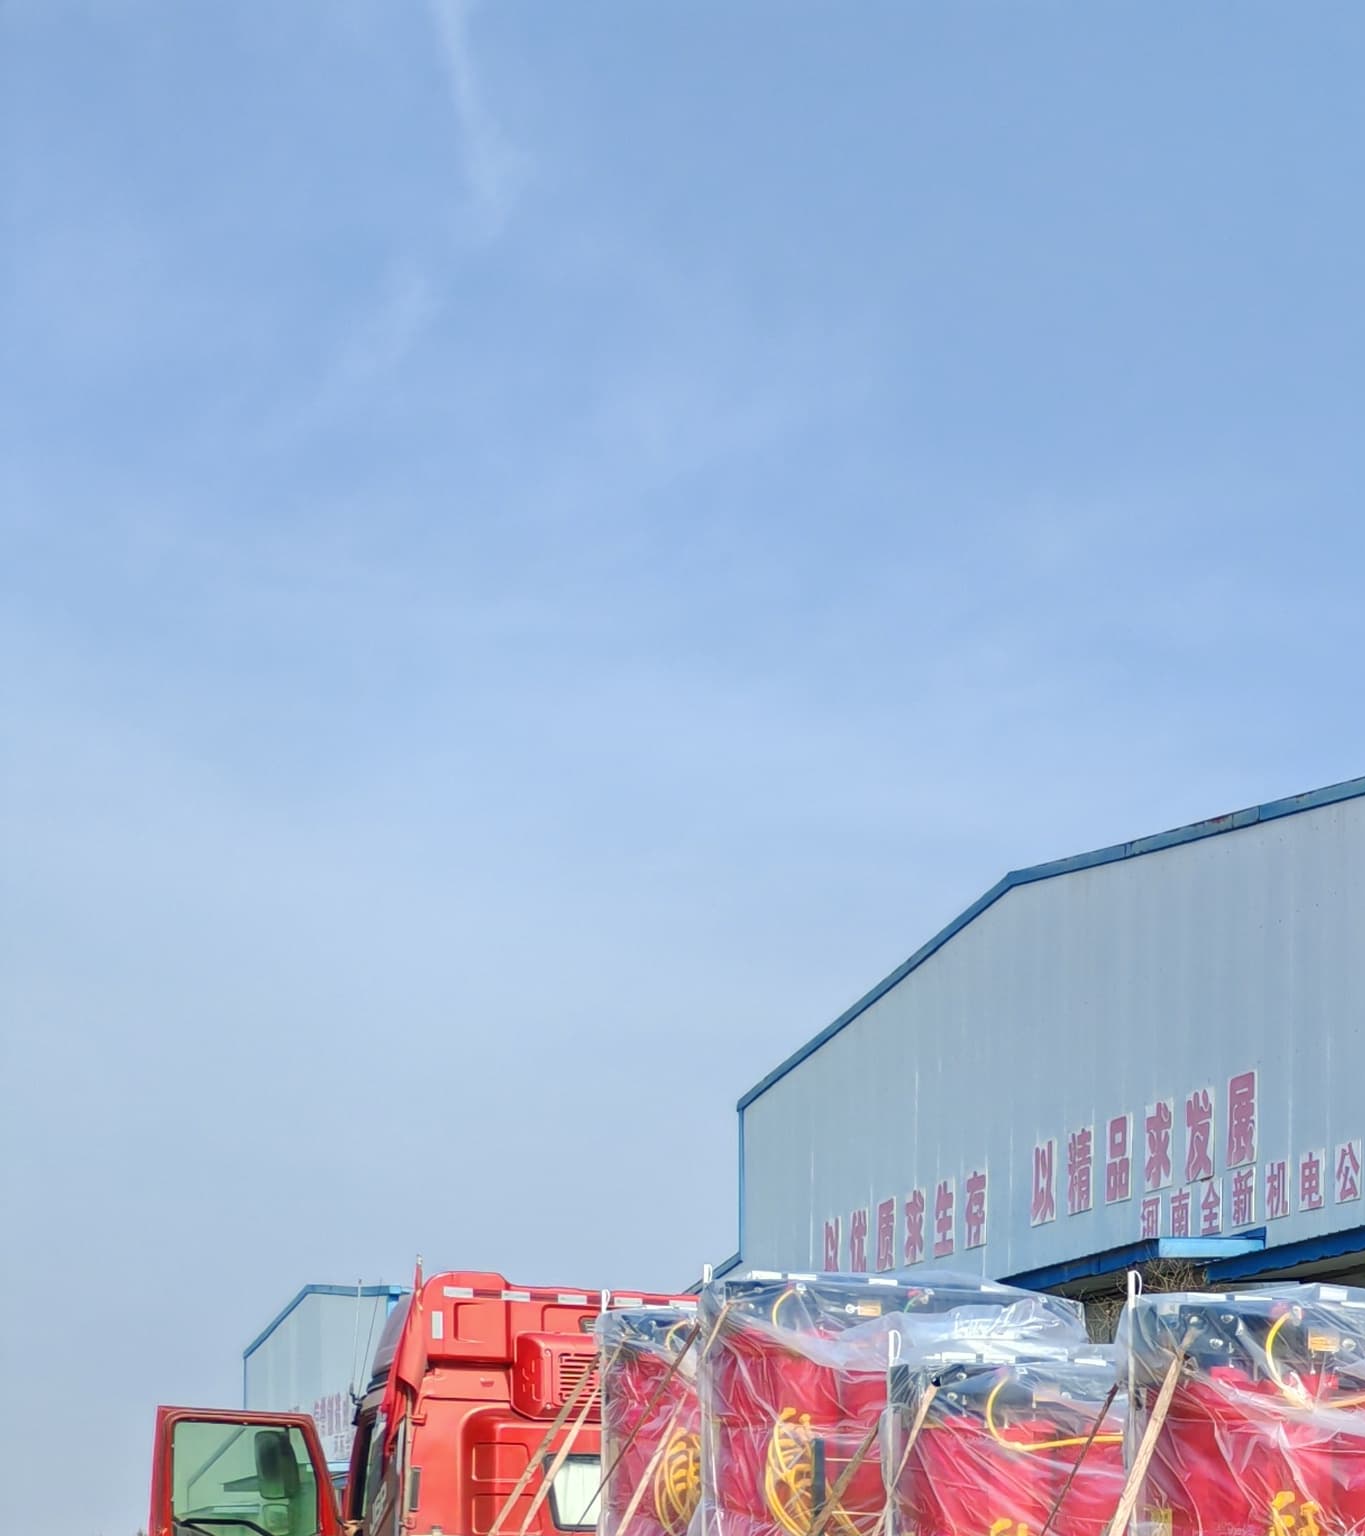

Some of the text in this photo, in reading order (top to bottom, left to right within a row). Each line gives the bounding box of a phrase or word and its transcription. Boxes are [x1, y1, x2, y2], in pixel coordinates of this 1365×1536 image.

[823, 1072, 1256, 1272] 以优质求生存 以精品求发展
